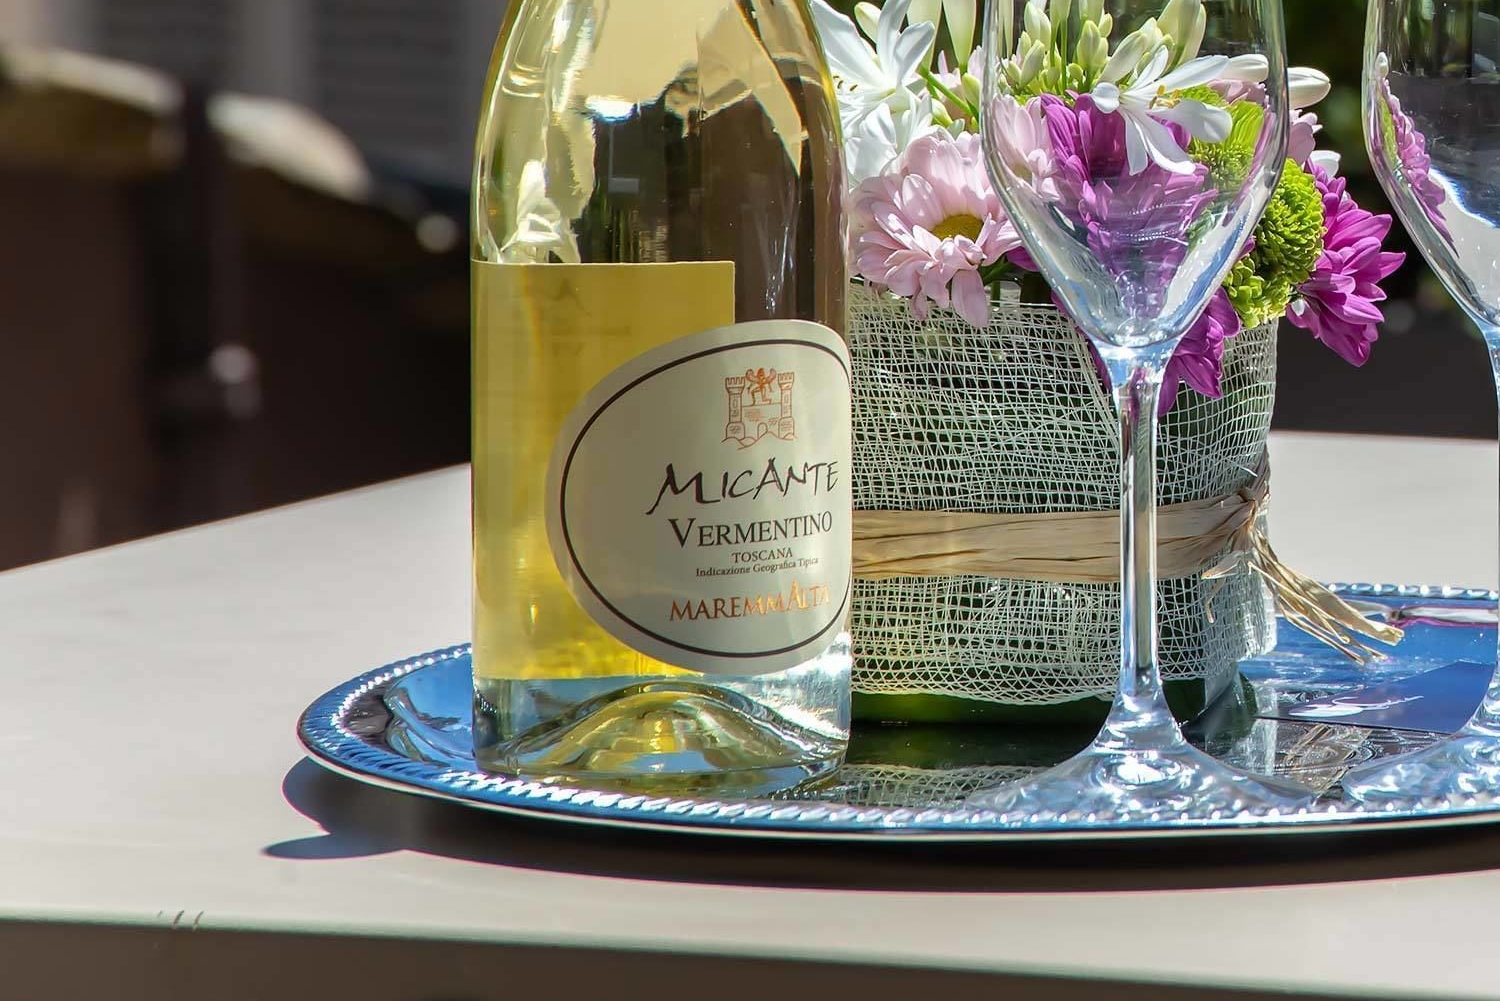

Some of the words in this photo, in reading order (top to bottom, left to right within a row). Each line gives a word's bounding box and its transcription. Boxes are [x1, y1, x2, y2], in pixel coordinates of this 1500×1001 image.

[645, 457, 839, 516] MICANTE
[668, 510, 833, 548] VERMENTINO
[695, 564, 751, 577] Indicazione
[752, 559, 796, 574] Geografica
[799, 556, 819, 568] Tipica
[731, 547, 793, 564] TOSCANA
[669, 581, 832, 622] MAREMMALTA
